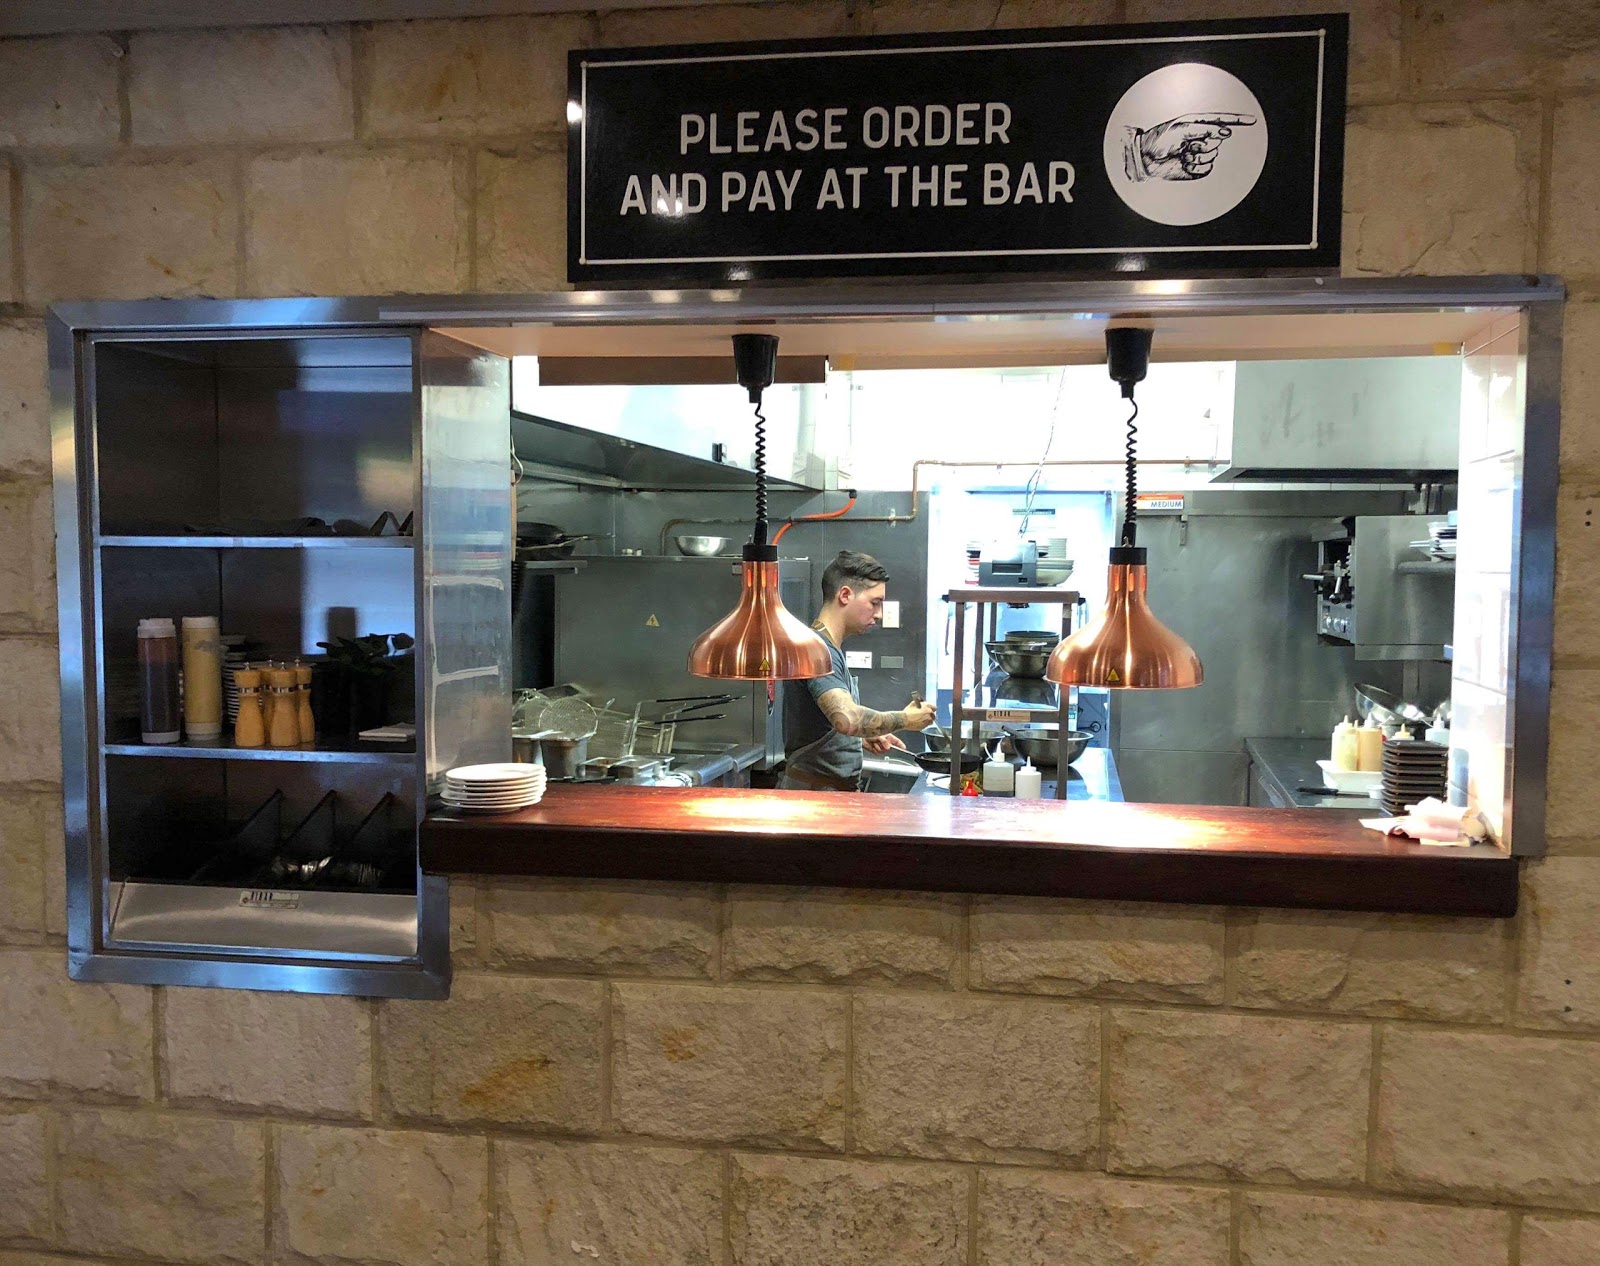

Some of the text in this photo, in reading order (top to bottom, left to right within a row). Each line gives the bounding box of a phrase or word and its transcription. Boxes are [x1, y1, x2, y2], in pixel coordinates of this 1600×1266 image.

[680, 102, 1012, 155] PLEASE ORDER
[619, 160, 1076, 216] AND PAY AT THE BAR
